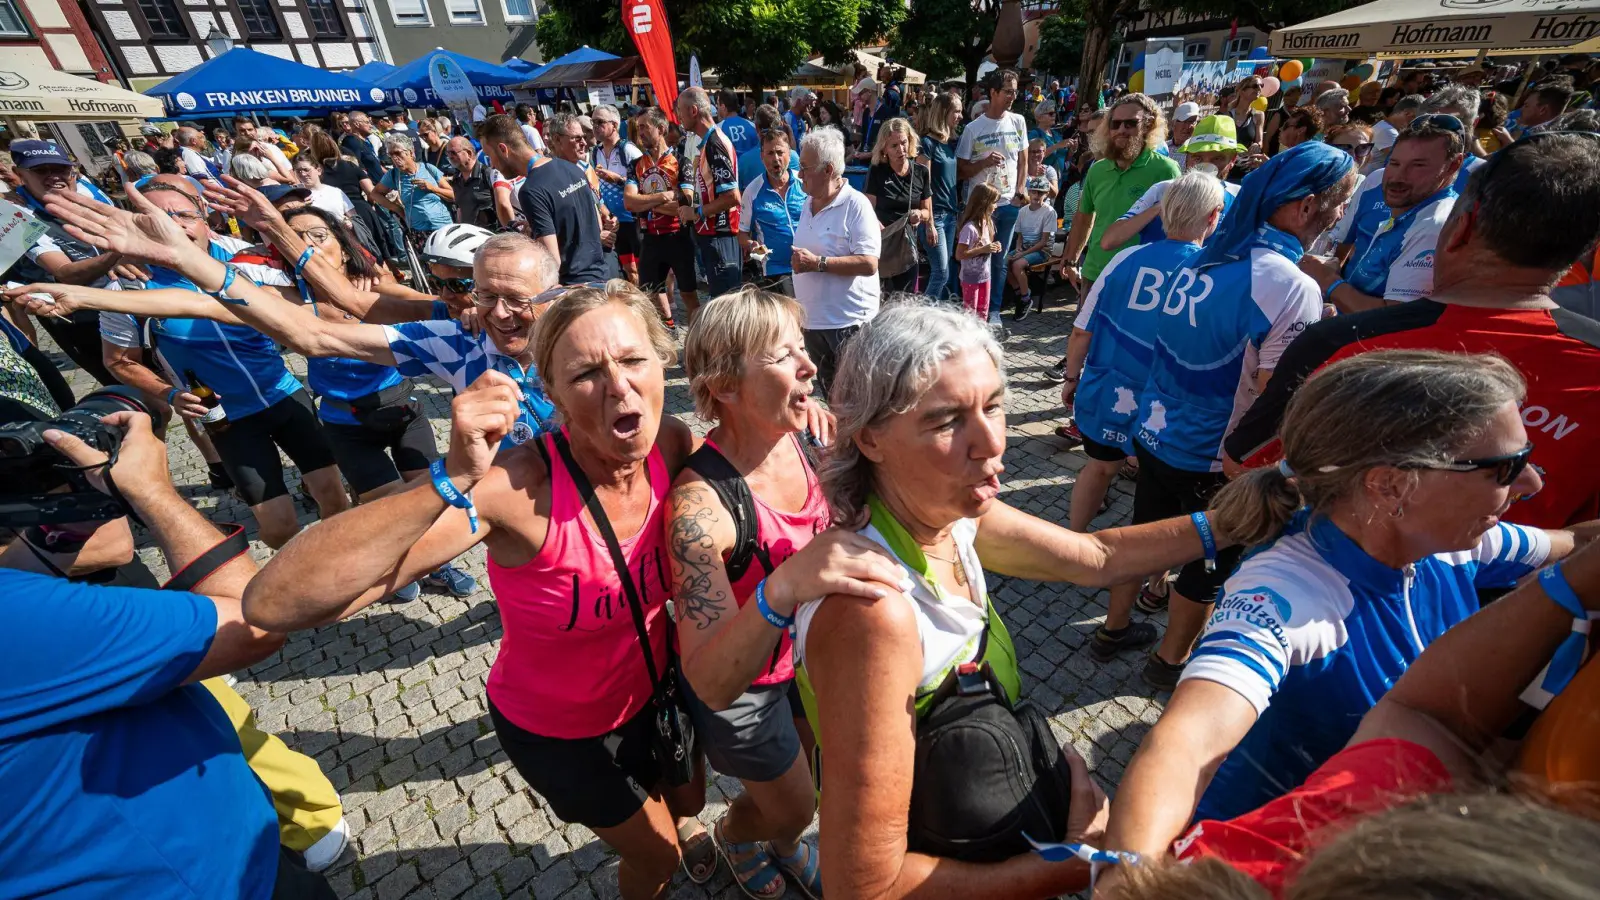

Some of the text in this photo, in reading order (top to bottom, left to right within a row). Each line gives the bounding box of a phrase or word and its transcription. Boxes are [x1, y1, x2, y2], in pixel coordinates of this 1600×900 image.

[1390, 23, 1493, 45] Hofmann
[1530, 16, 1600, 39] Hofm
[1281, 32, 1361, 49] Hofmann
[0, 99, 44, 111] mann
[67, 98, 138, 113] Hofmann
[205, 88, 361, 107] FRANKEN BRUNNEN
[729, 125, 747, 142] BR
[1163, 266, 1214, 328] BR
[1518, 401, 1580, 441] ON
[439, 481, 458, 500] 0039
